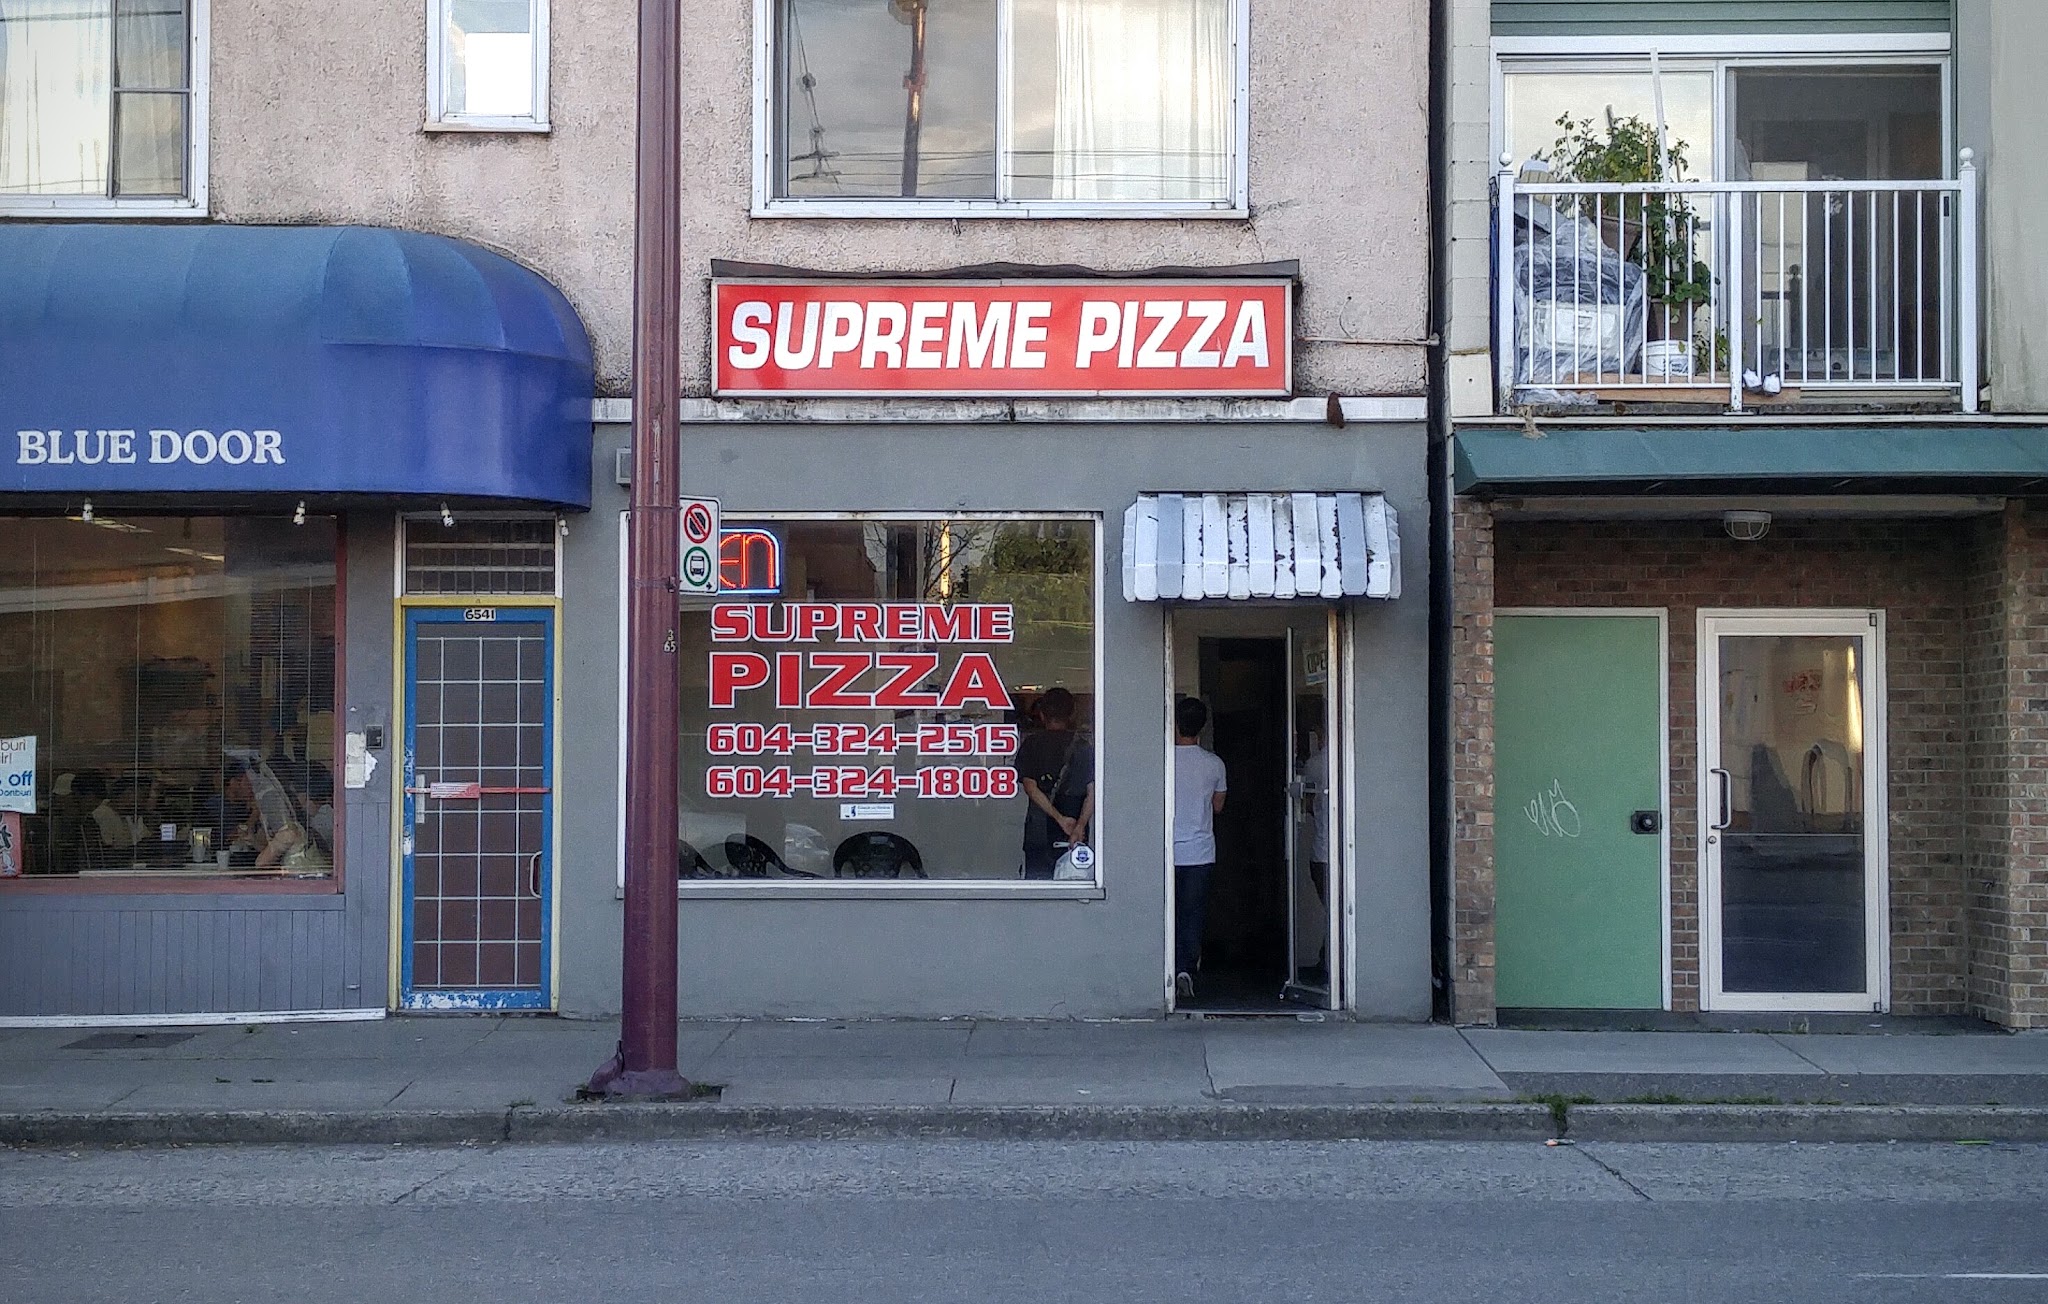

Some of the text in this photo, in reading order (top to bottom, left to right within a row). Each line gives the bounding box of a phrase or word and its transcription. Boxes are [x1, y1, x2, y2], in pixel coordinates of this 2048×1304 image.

[728, 300, 1270, 370] SUPREME PIZZA
[17, 430, 286, 465] BLUE DOOR
[465, 609, 496, 620] 6541
[711, 603, 1015, 643] SUPREME
[708, 652, 1015, 710] PIZZA
[706, 723, 1018, 756] 604-324-2515
[8, 769, 33, 786] off
[706, 765, 1018, 799] 604-324-1808
